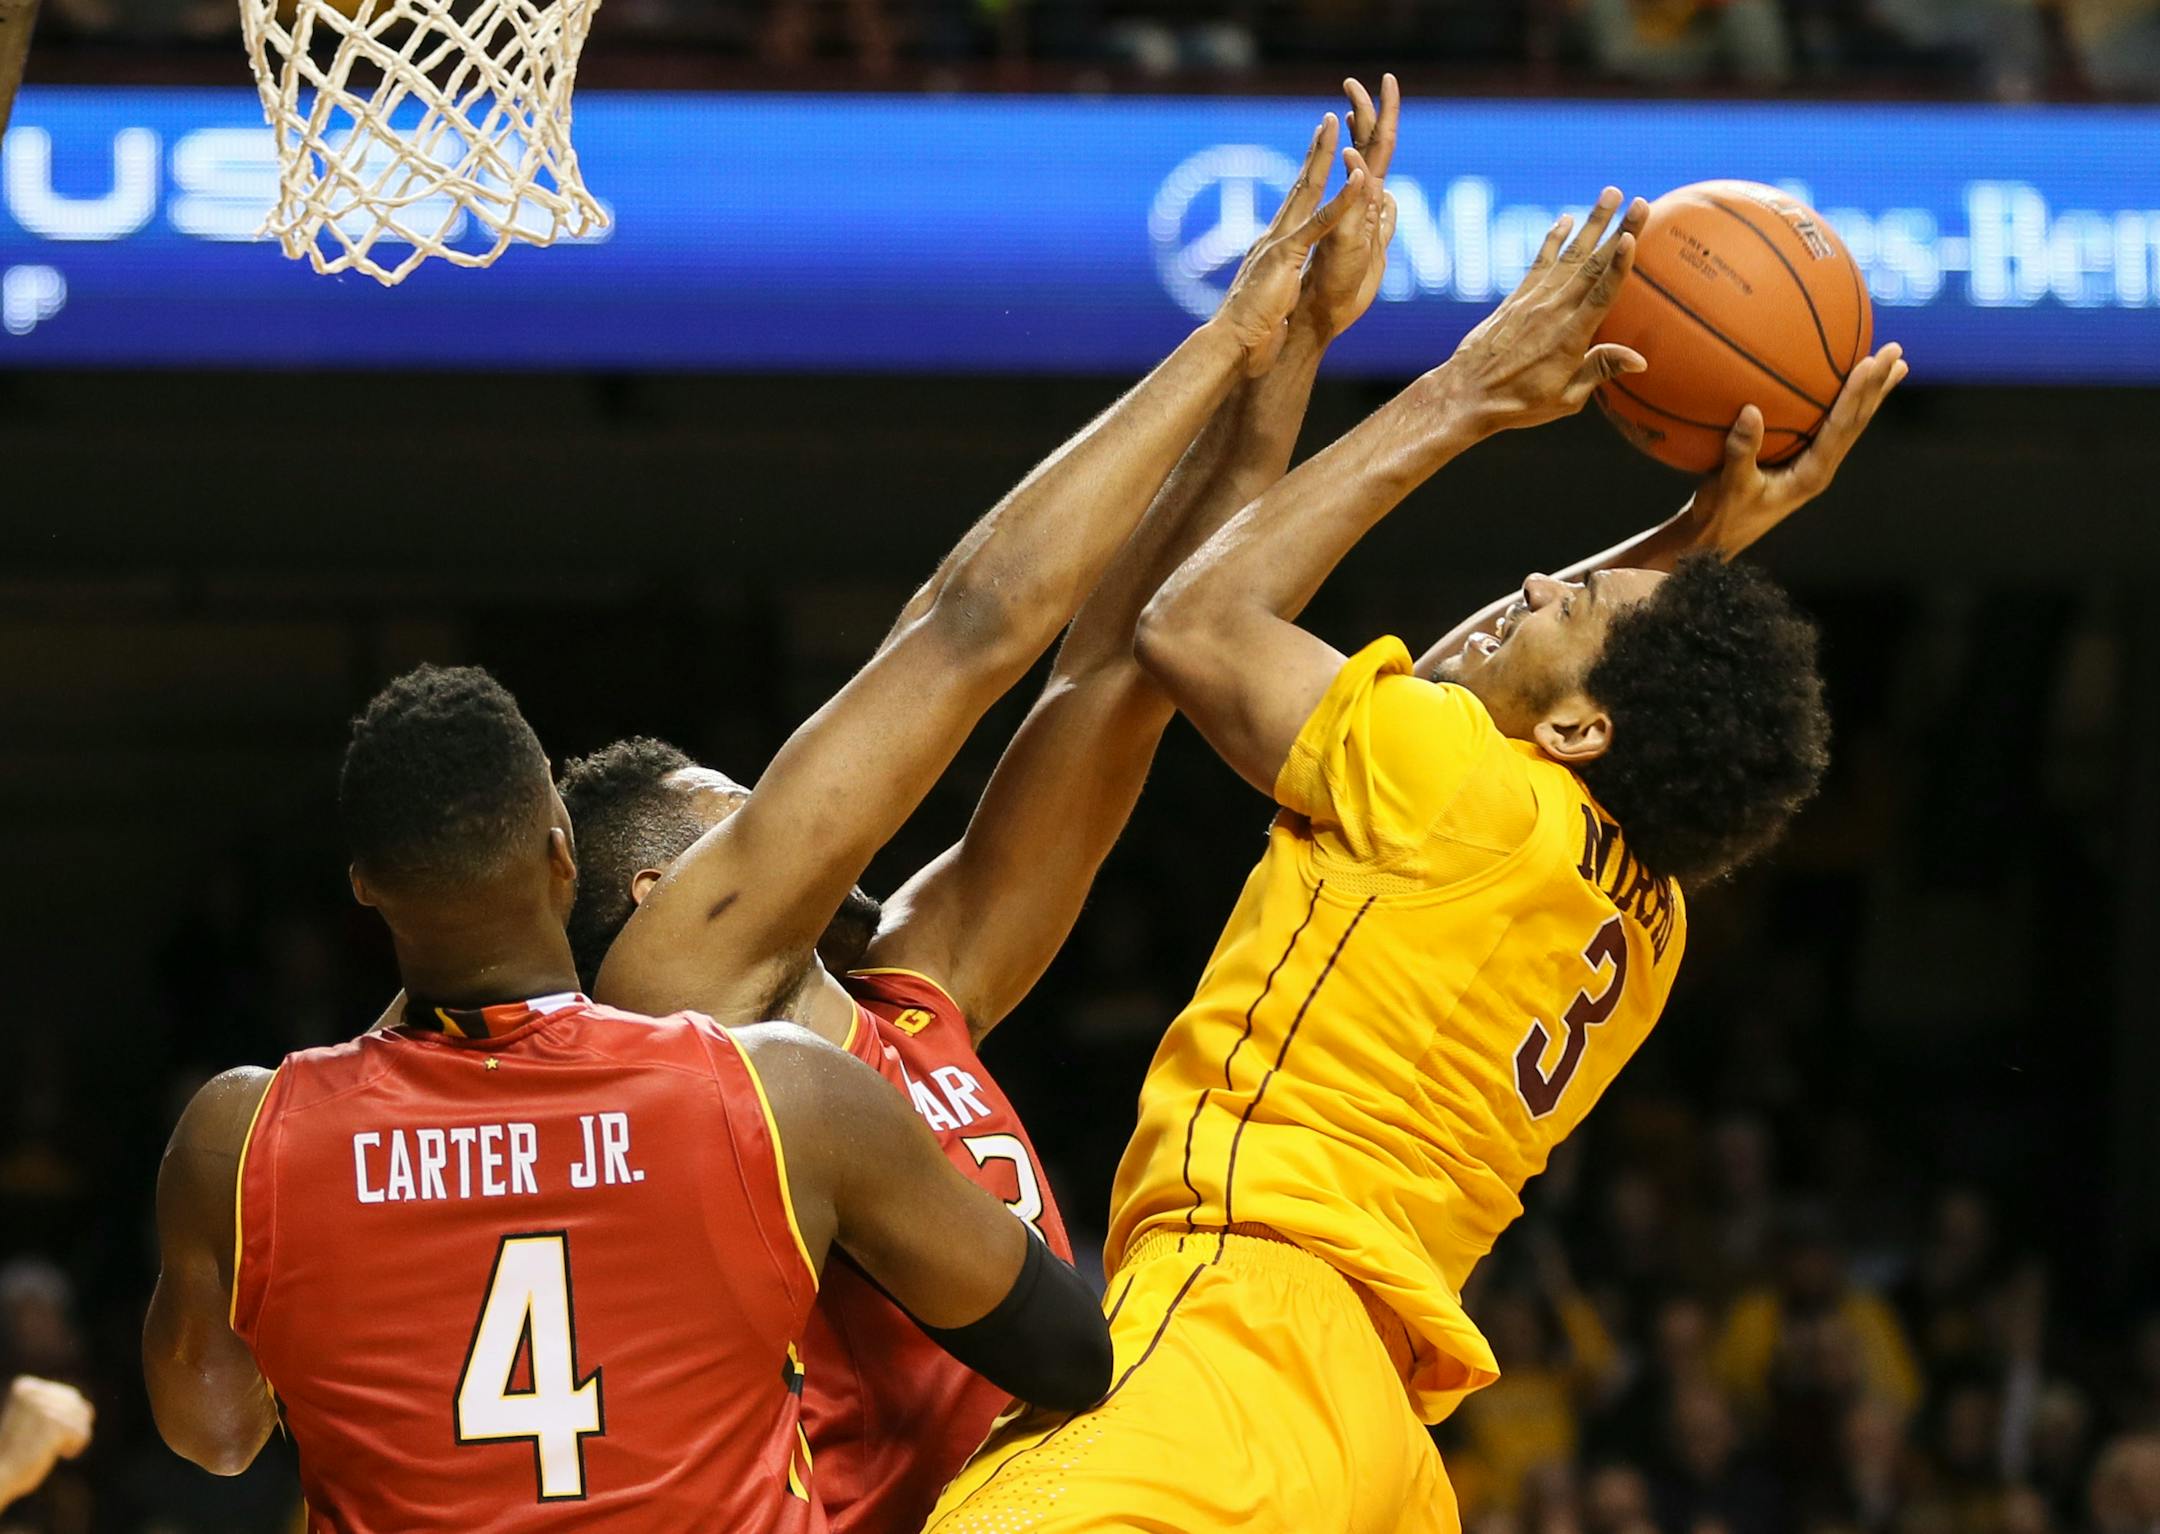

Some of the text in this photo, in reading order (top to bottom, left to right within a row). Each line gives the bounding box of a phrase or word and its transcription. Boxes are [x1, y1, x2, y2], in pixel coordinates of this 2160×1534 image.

[1512, 911, 1629, 1122] 3
[353, 1110, 646, 1204] CARTER JR.
[454, 1229, 605, 1504] 4
